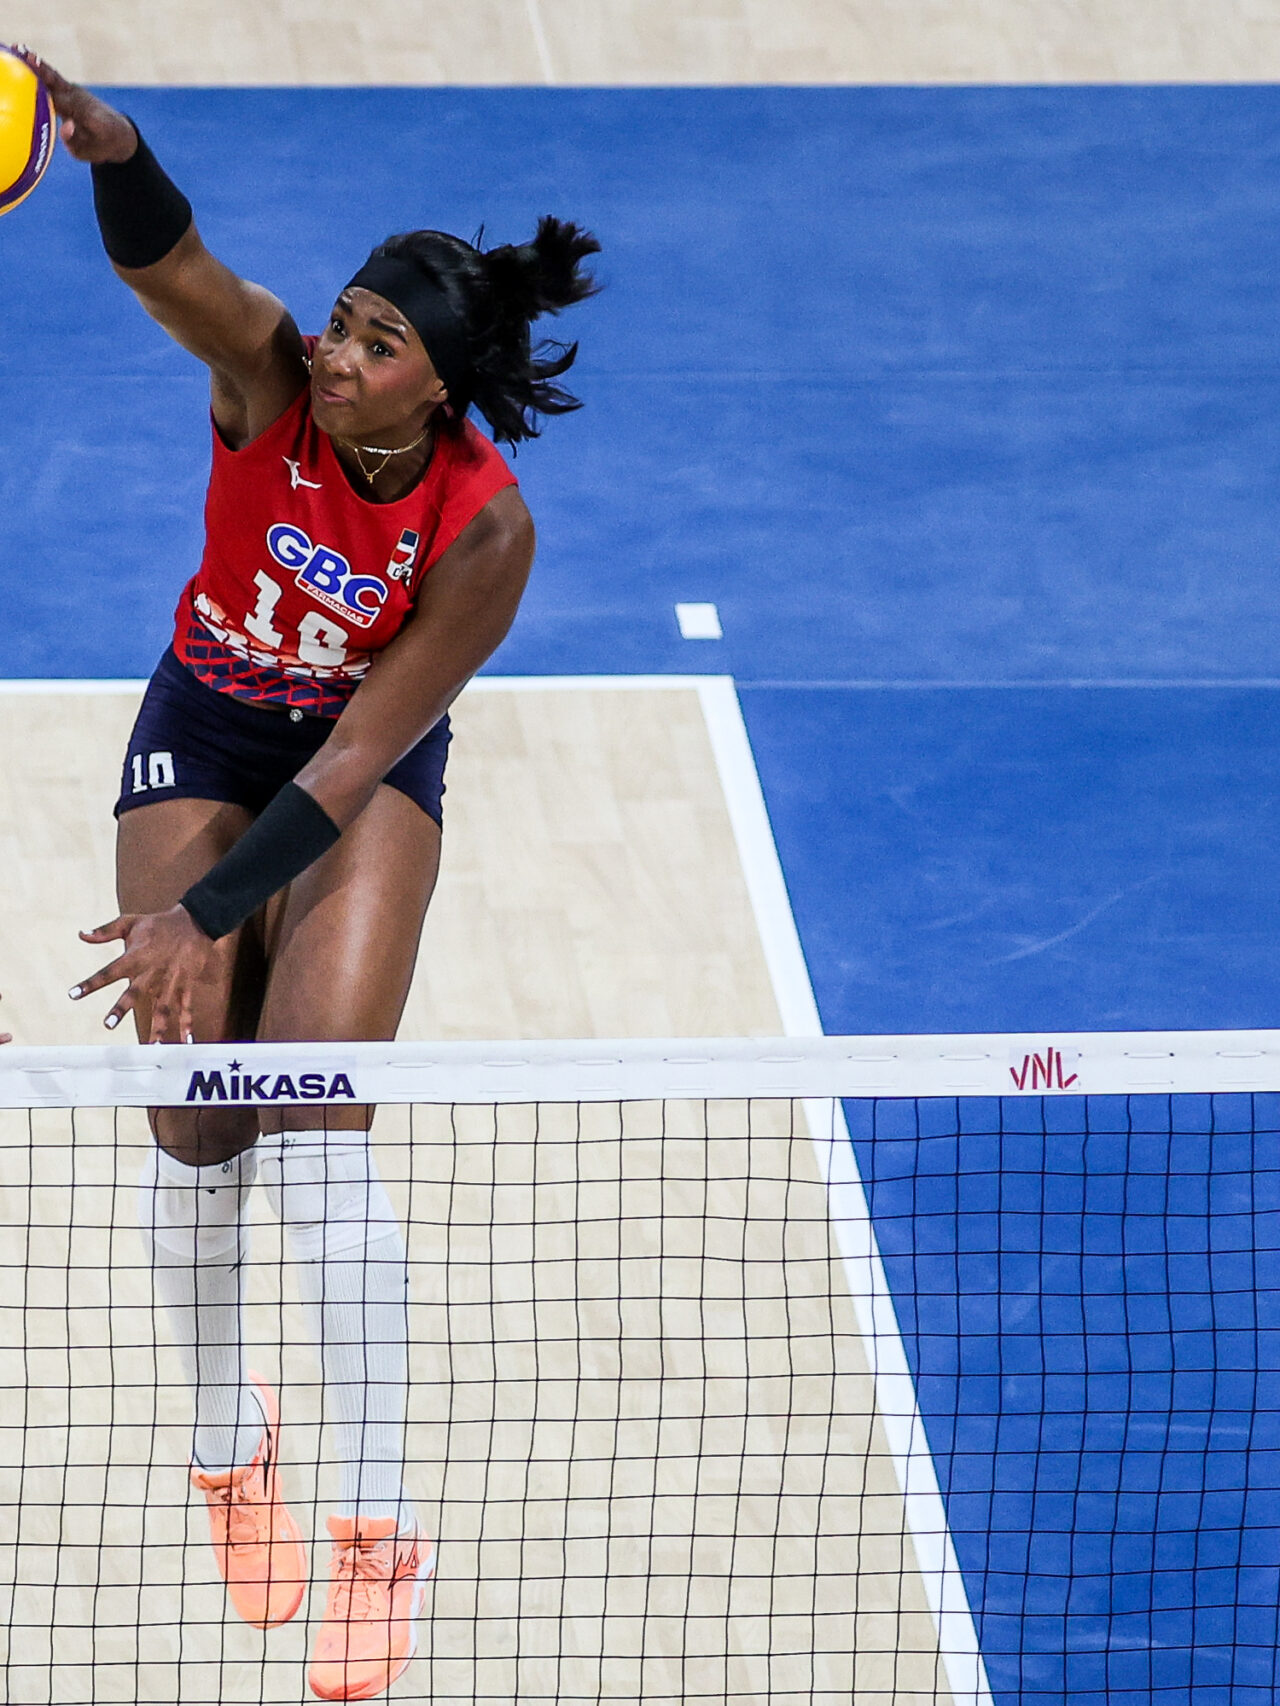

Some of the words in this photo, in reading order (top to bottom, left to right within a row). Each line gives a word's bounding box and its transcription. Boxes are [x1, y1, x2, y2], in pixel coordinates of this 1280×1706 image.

[268, 524, 387, 617] GBC
[305, 583, 365, 625] FARMACIAS
[131, 751, 176, 794] 10
[1009, 1047, 1078, 1090] VNL
